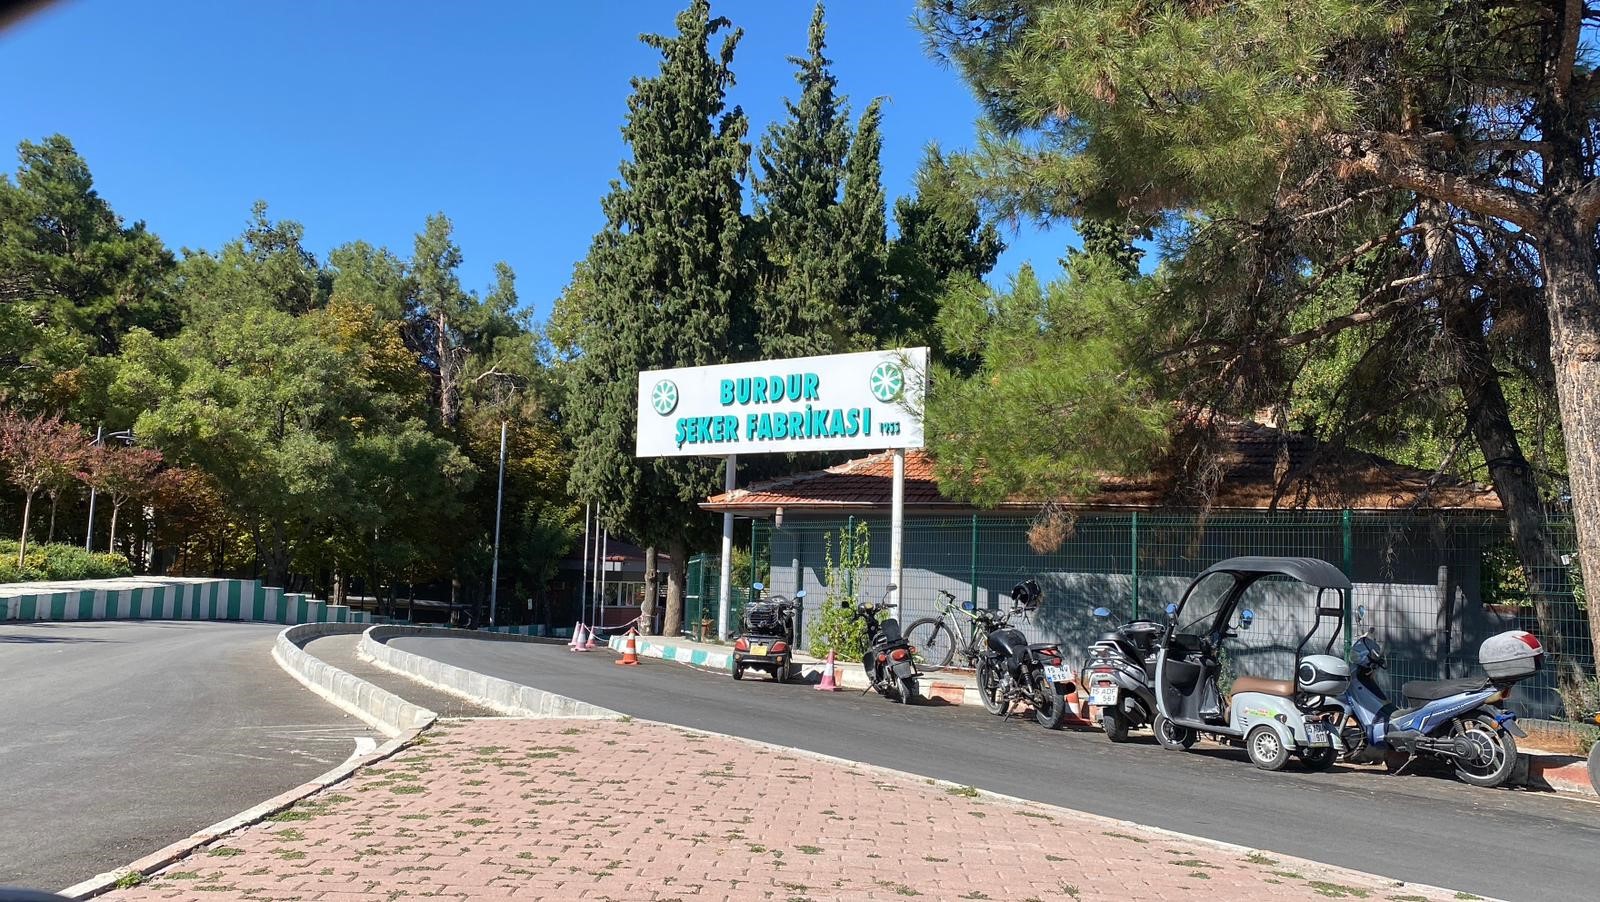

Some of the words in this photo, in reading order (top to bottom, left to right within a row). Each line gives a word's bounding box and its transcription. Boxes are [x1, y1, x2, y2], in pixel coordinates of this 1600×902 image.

[719, 373, 820, 406] BURDUR
[675, 414, 739, 449] ŞEKER
[746, 404, 871, 443] FABRİKASI
